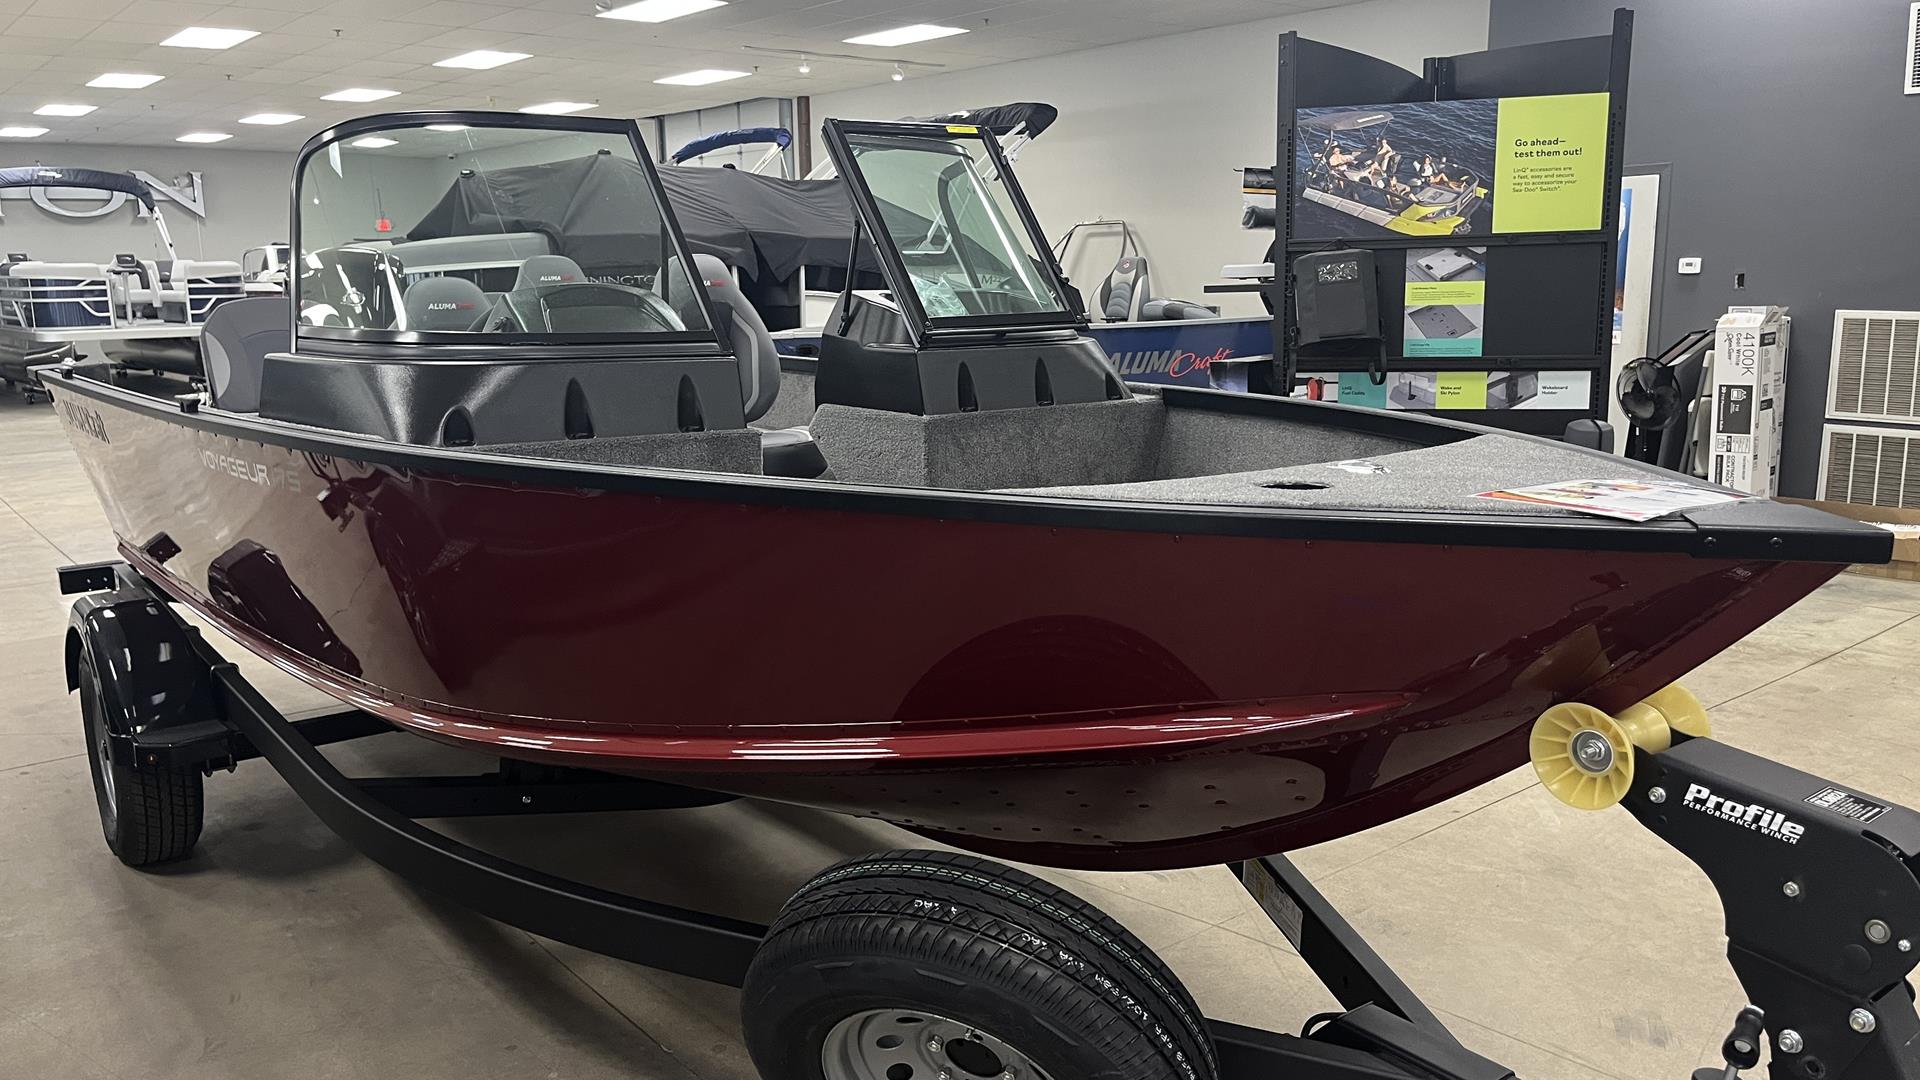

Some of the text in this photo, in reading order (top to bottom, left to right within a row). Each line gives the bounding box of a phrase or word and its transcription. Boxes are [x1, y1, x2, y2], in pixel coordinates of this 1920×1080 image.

[1514, 138, 1528, 147] Go
[1514, 147, 1583, 158] test them out!
[0, 170, 206, 218] ON
[1741, 332, 1755, 376] 4100K
[197, 447, 270, 486] VOYAGEUR
[1682, 799, 1798, 845] PERFORMANCE WINCH
[1684, 783, 1805, 839] Profile
